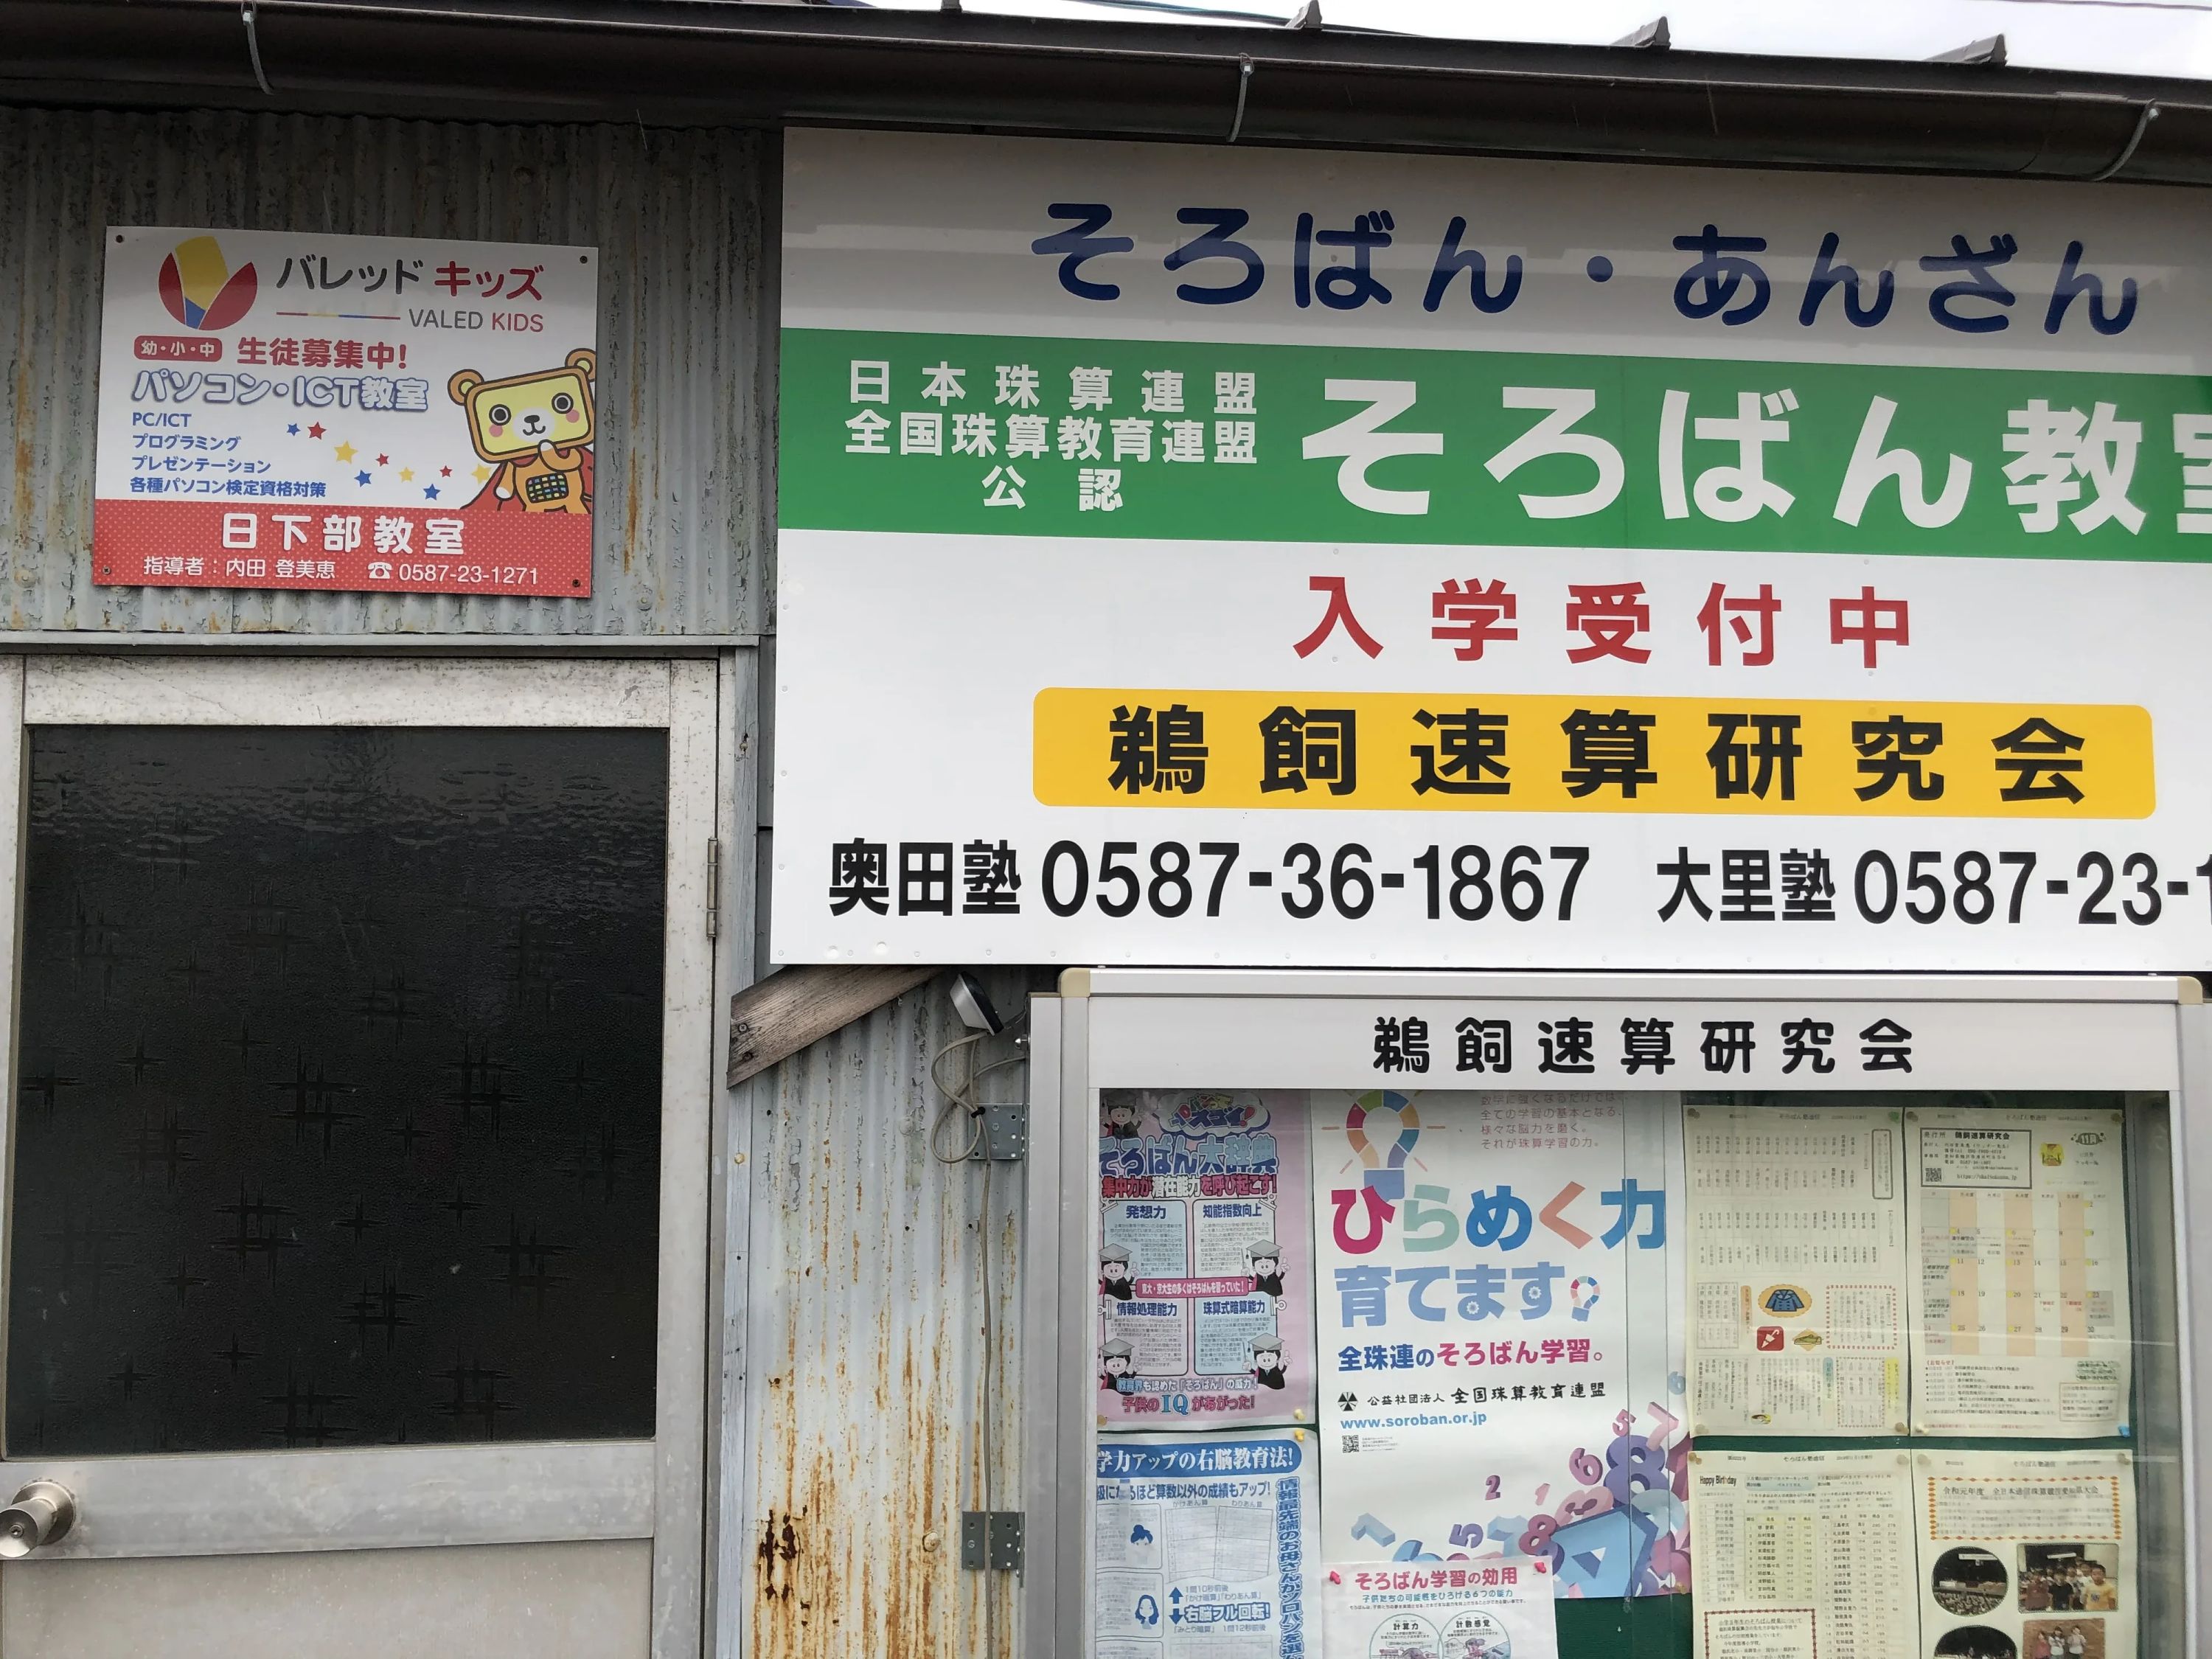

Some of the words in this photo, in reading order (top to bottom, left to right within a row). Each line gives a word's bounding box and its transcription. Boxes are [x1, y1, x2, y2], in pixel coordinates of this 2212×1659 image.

[276, 255, 424, 293] バレッド
[434, 260, 544, 302] キッズ
[1032, 203, 2139, 336] そろばん・あんざん
[409, 308, 484, 331] VALED
[491, 312, 544, 334] KIDS
[141, 340, 215, 360] 幼・小・中
[237, 336, 408, 369] 生徒募集中!
[131, 370, 428, 412] パソコン・ICT教室
[849, 360, 1257, 416] 日本珠算連盟
[132, 411, 192, 428] PC/ICT
[132, 434, 241, 453] プログラミング
[845, 408, 1258, 465] 全国珠算教育連盟
[131, 455, 271, 474] プレゼンテーション
[1302, 378, 2212, 536] そろばん教
[130, 477, 327, 499] 各種パソコン検定資格対策
[981, 465, 1123, 513] 公認
[222, 512, 465, 556] 日下部教室
[398, 563, 538, 585] 0587-23-1271
[1293, 576, 1910, 669] 入学受付中
[1107, 703, 2086, 805] 鵜飼速算研究会
[829, 837, 1022, 917] 奥田塾
[1041, 839, 1590, 923] 0587-36-1867
[1656, 846, 1836, 923] 大里塾
[1374, 1015, 1913, 1075] 鵜飼速算研究会
[1099, 1133, 1280, 1178] そろばん大辞典
[1126, 1205, 1166, 1220] 発想力
[1203, 1203, 1262, 1219] 知能指数向上
[1332, 1178, 1666, 1255] ひらめく力
[1116, 1301, 1178, 1317] 情報処理能力
[1203, 1300, 1266, 1315] 珠算式暗算能力
[1338, 1339, 1604, 1372] 全珠連のそろばん学習。
[1367, 1392, 1445, 1405] 公益社団法人
[1450, 1382, 1607, 1405] 全国珠算教育連盟
[1340, 1411, 1487, 1430] www.soroban.or.jp
[1097, 1447, 1294, 1473] 学力アップの右脳教育法!
[1569, 1447, 1603, 1486] 6
[1485, 1475, 1500, 1500] 2
[1700, 1475, 1714, 1486] Happy
[1716, 1475, 1736, 1486] Birthday
[1355, 1567, 1517, 1590] そろばん学習の効用
